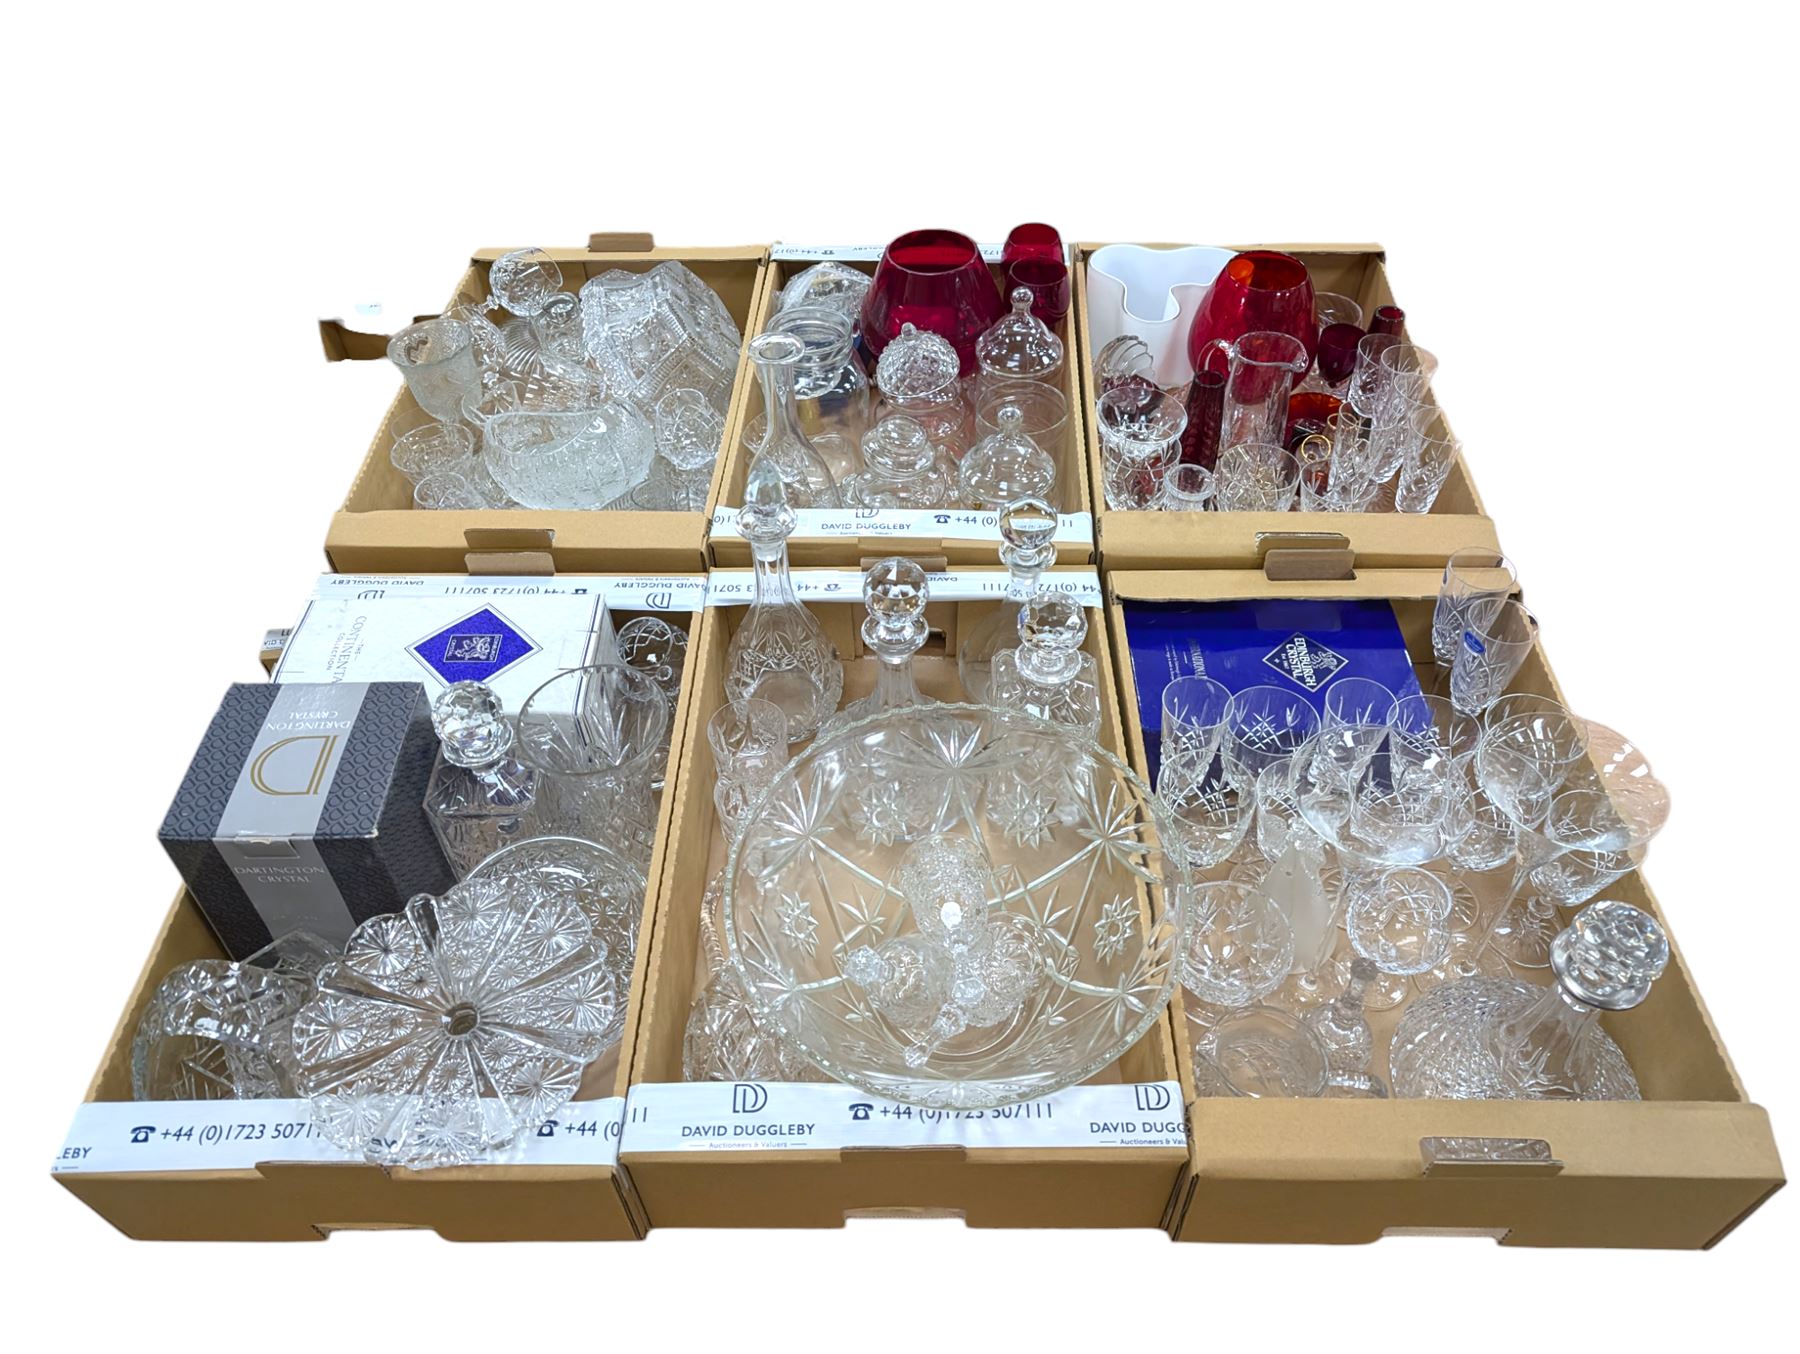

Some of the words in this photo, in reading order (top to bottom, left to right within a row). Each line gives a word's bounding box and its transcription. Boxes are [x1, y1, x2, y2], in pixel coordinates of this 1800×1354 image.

[954, 515, 977, 525] +44
[821, 522, 852, 531] DAVID
[856, 522, 912, 531] DUGGLEBY
[613, 581, 673, 589] DUGGLEBY
[1038, 582, 1077, 592] (0)172
[332, 615, 367, 684] CONTINENTA
[1286, 643, 1303, 679] CRYSTAL
[1294, 637, 1317, 686] EDINBURGH
[289, 711, 338, 720] CRYSTAL
[265, 720, 351, 731] DARTINGTON
[233, 866, 325, 874] DARTINGTON
[257, 875, 310, 883] CRYSTAL
[879, 1103, 913, 1120] +44
[565, 1120, 598, 1137] +44
[681, 1125, 728, 1138] DAVID
[733, 1123, 816, 1137] DUGGLEBY
[1089, 1121, 1137, 1134] DAVID
[1141, 1121, 1186, 1134] DUGG
[160, 1125, 194, 1142] +44
[199, 1123, 265, 1146] (0)1723
[1119, 1138, 1165, 1146] Auctioneers
